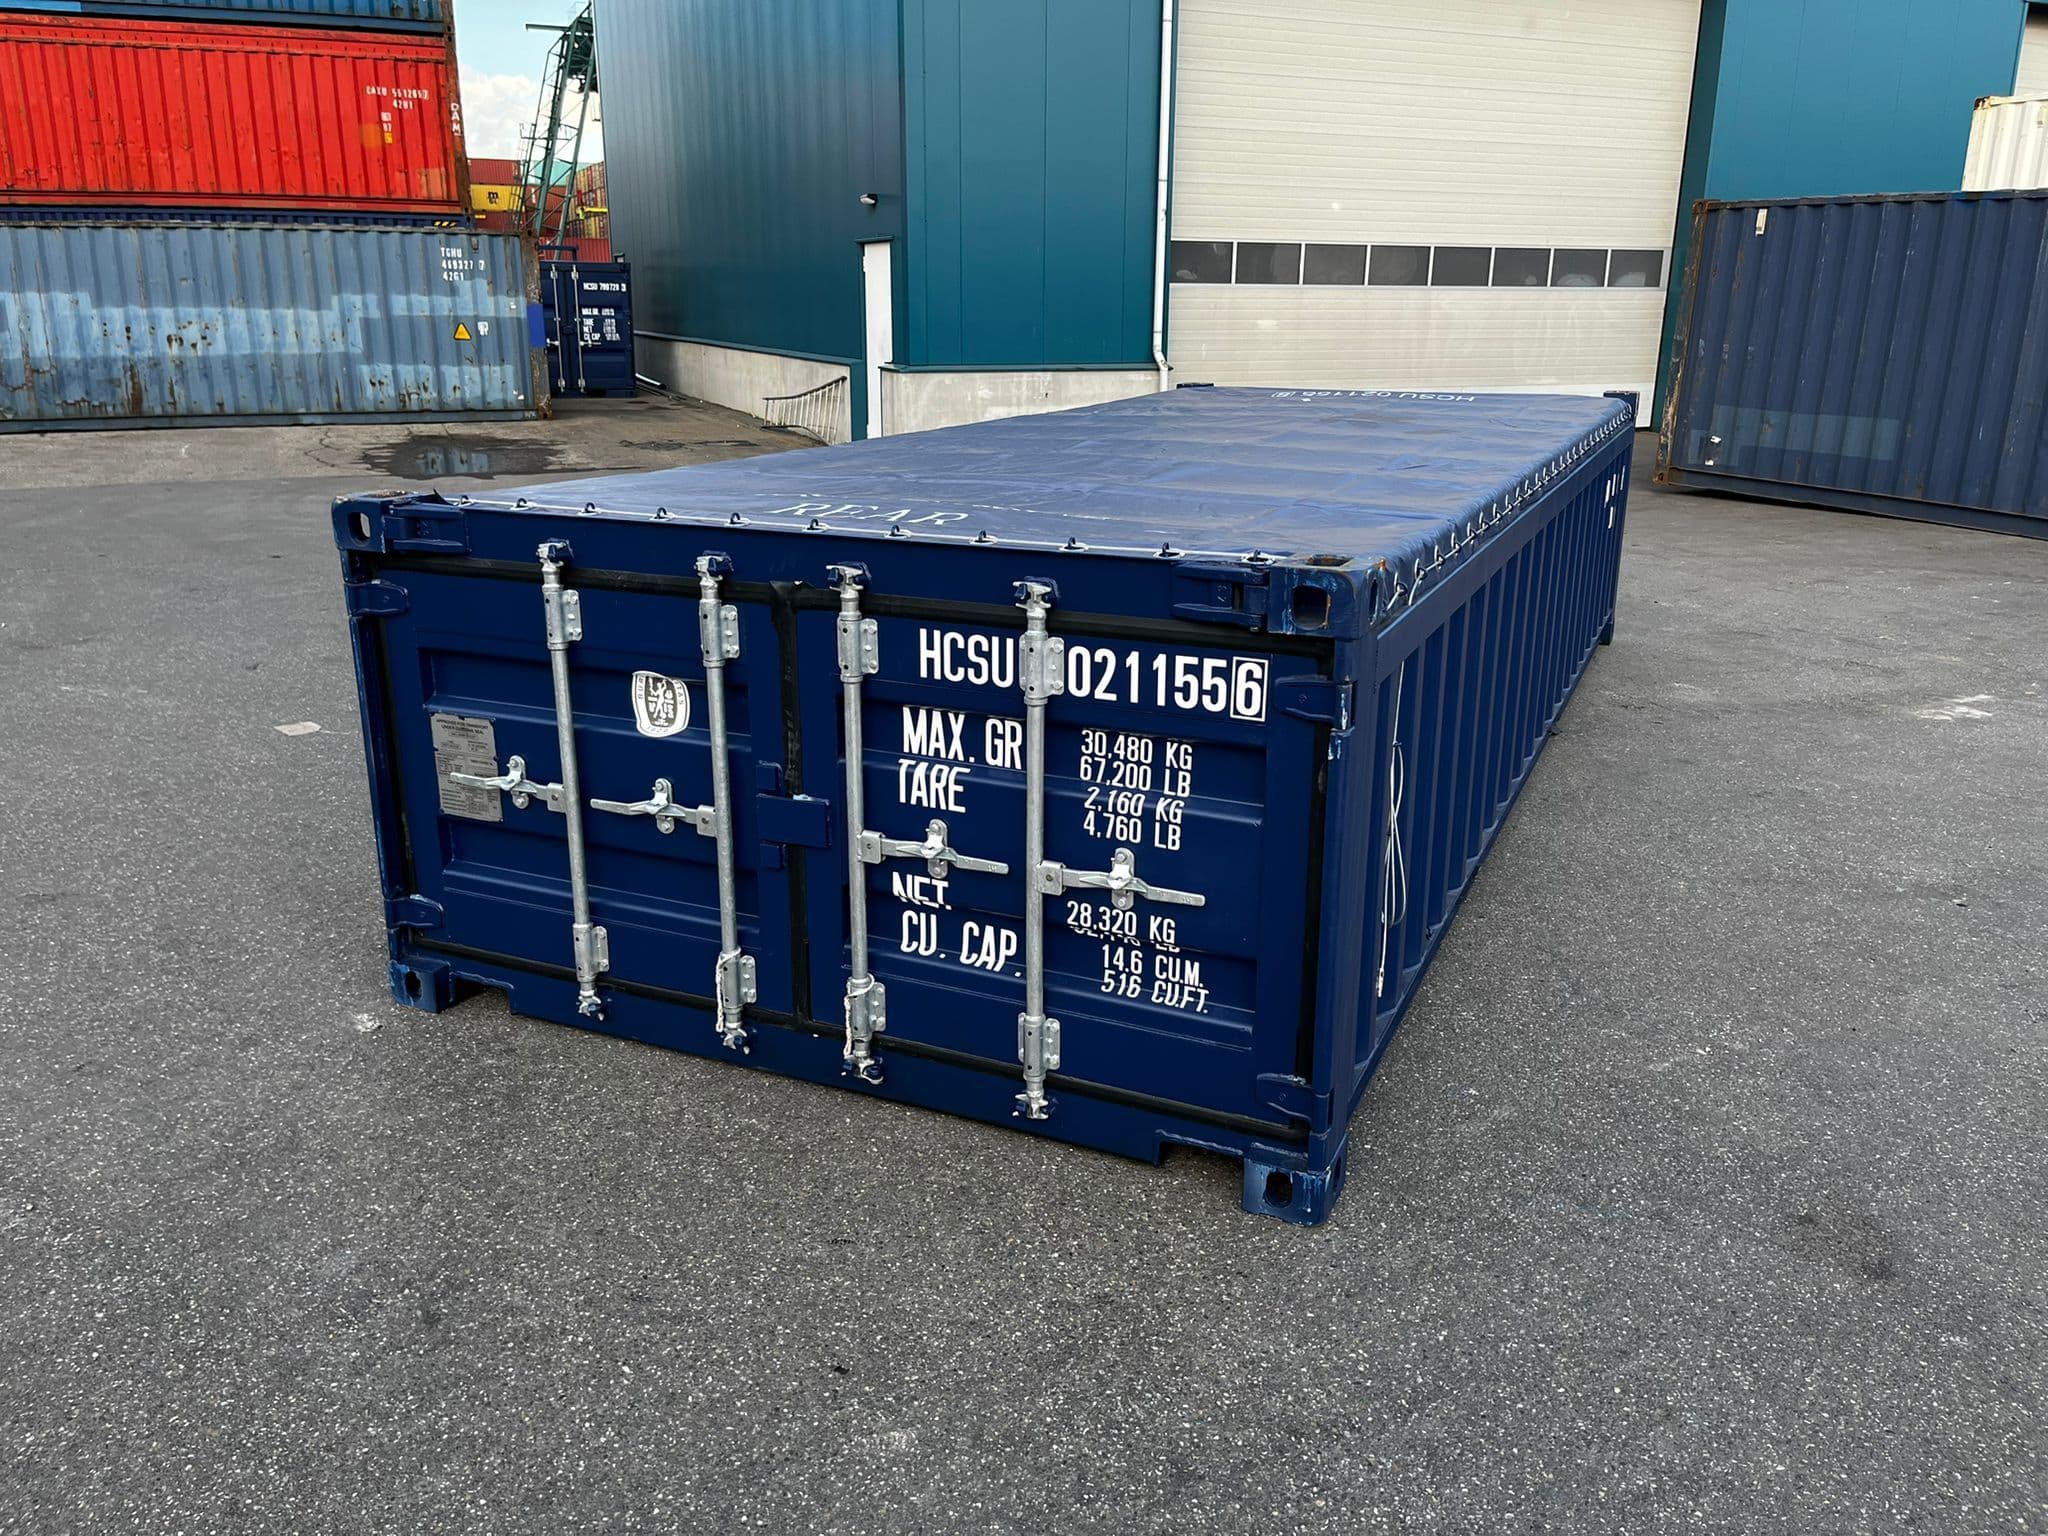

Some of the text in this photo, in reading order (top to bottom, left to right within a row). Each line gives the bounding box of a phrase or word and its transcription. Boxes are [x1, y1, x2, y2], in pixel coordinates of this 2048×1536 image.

[440, 247, 462, 258] TGHU
[764, 502, 969, 525] REAR
[919, 627, 1014, 688] HCSU
[902, 706, 975, 763] MAX.
[1081, 729, 1193, 771] 30,480 KG
[898, 758, 971, 813] TARE
[1080, 755, 1191, 798] 67,200 LB
[1084, 786, 1185, 824] 2,160 KG
[1083, 810, 1181, 851] 4,760 LB
[892, 871, 952, 911] NET.
[900, 909, 946, 959] CU.
[959, 920, 1022, 977] CAP.
[1149, 914, 1176, 944] KG
[1102, 943, 1204, 988] 14.6 CU.M.
[1100, 969, 1210, 1014] 516 CU.FT.
